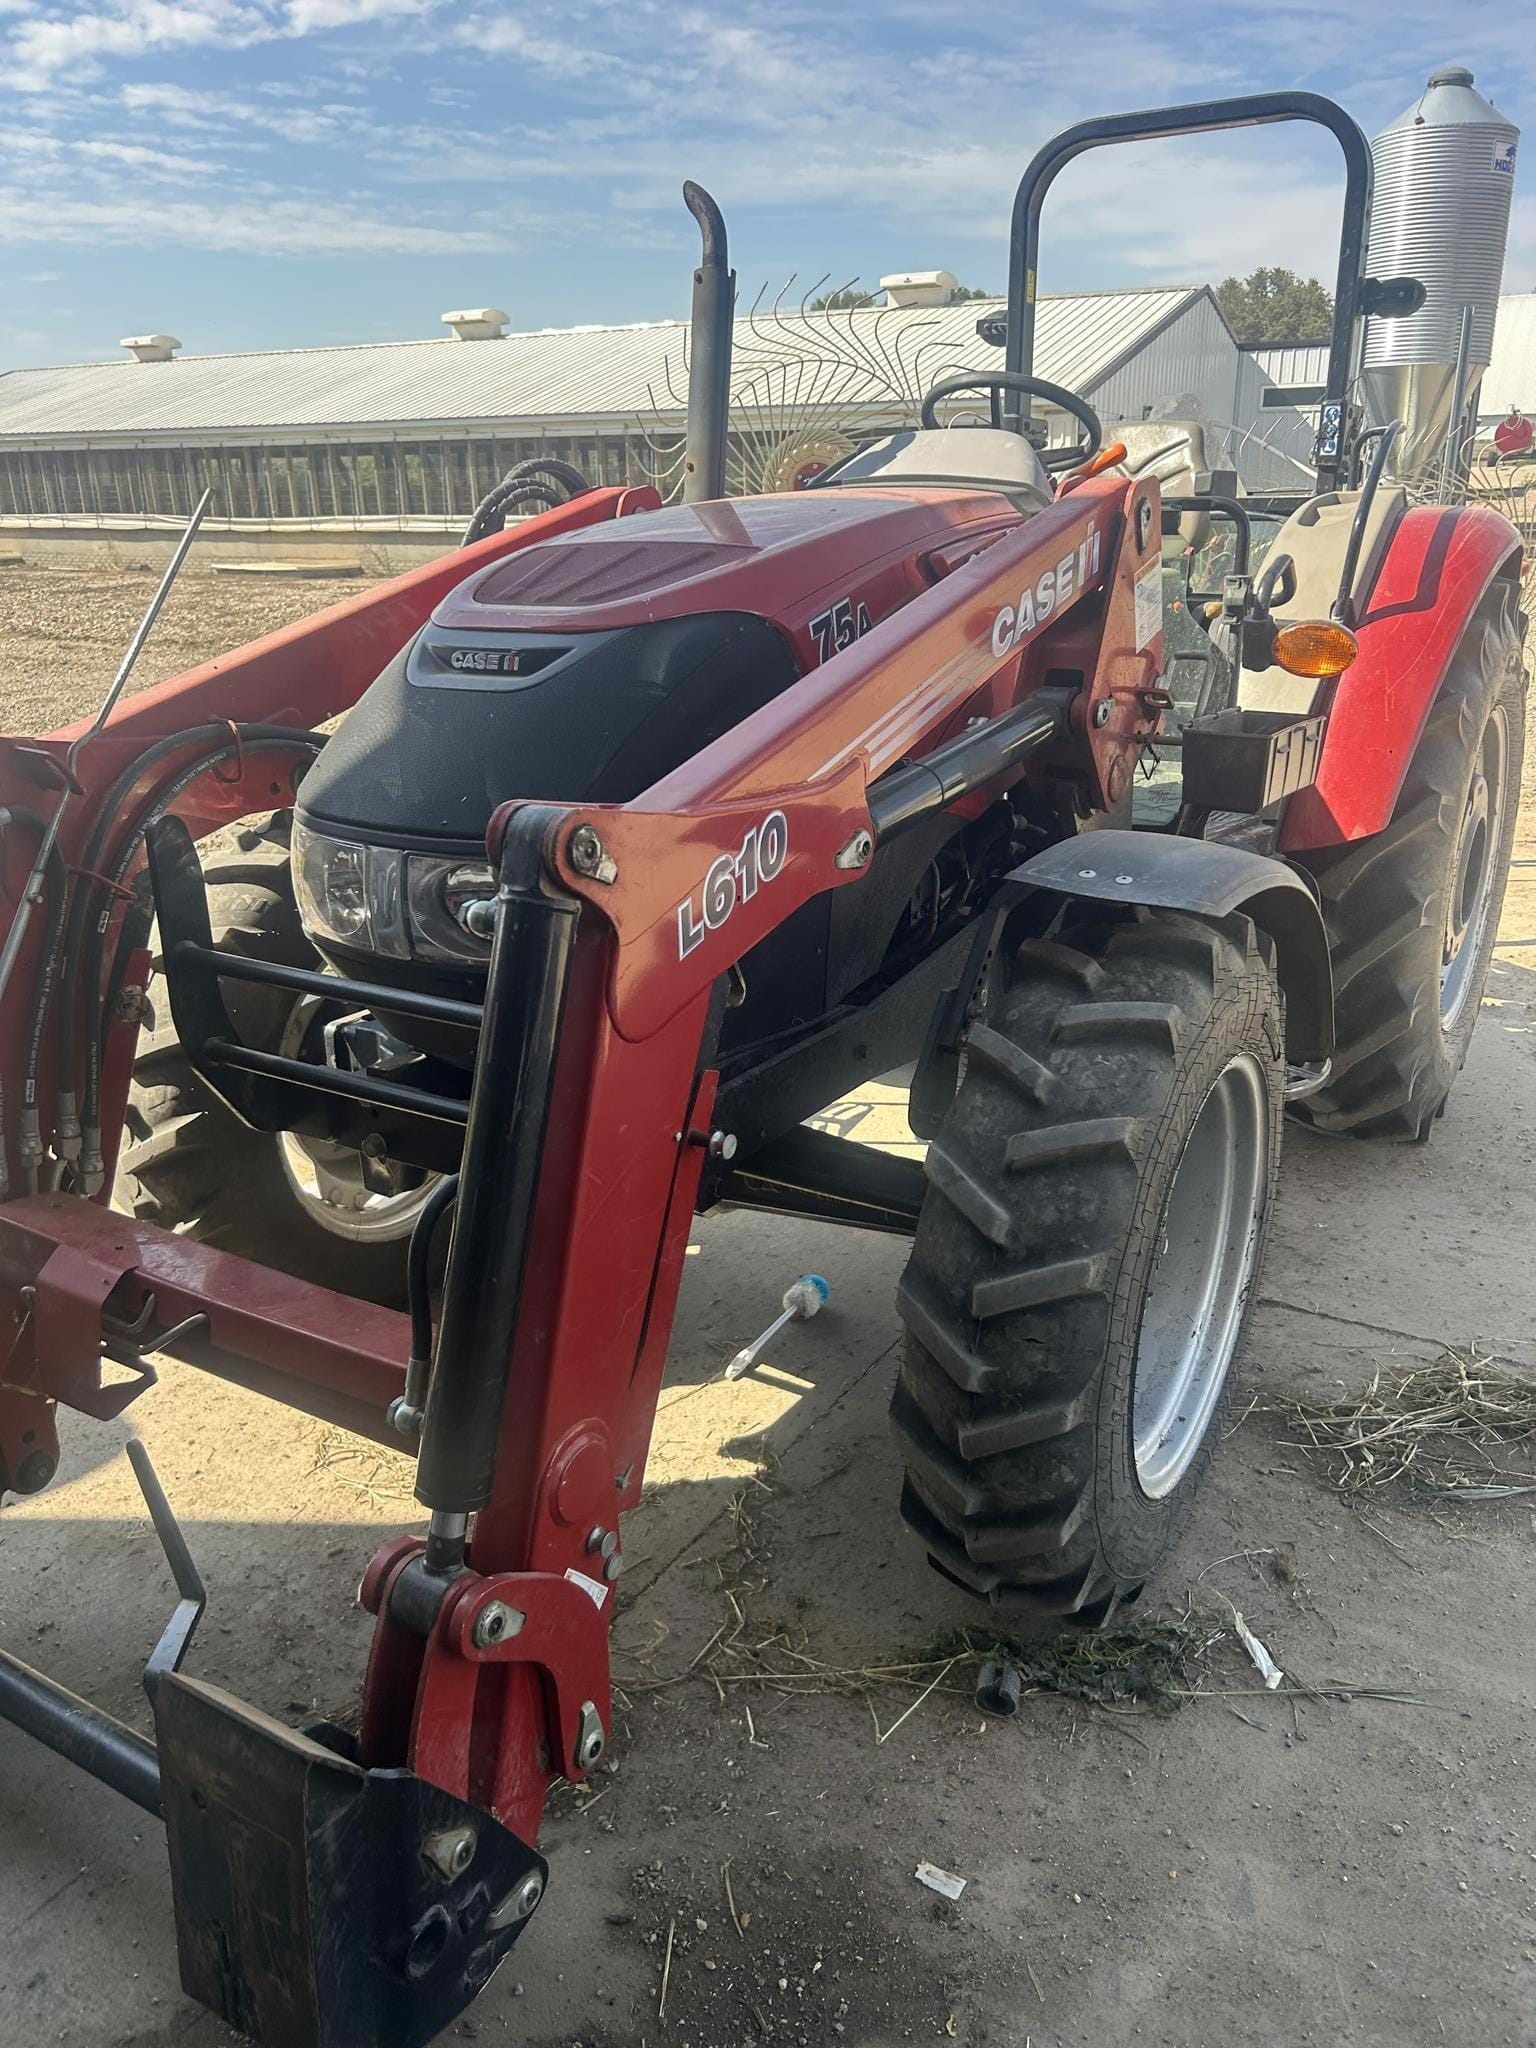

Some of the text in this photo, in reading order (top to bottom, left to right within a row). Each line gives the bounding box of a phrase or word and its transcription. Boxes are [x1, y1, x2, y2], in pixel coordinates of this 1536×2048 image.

[992, 551, 1075, 658] CASE
[451, 649, 501, 670] CASE
[677, 809, 788, 961] L610
